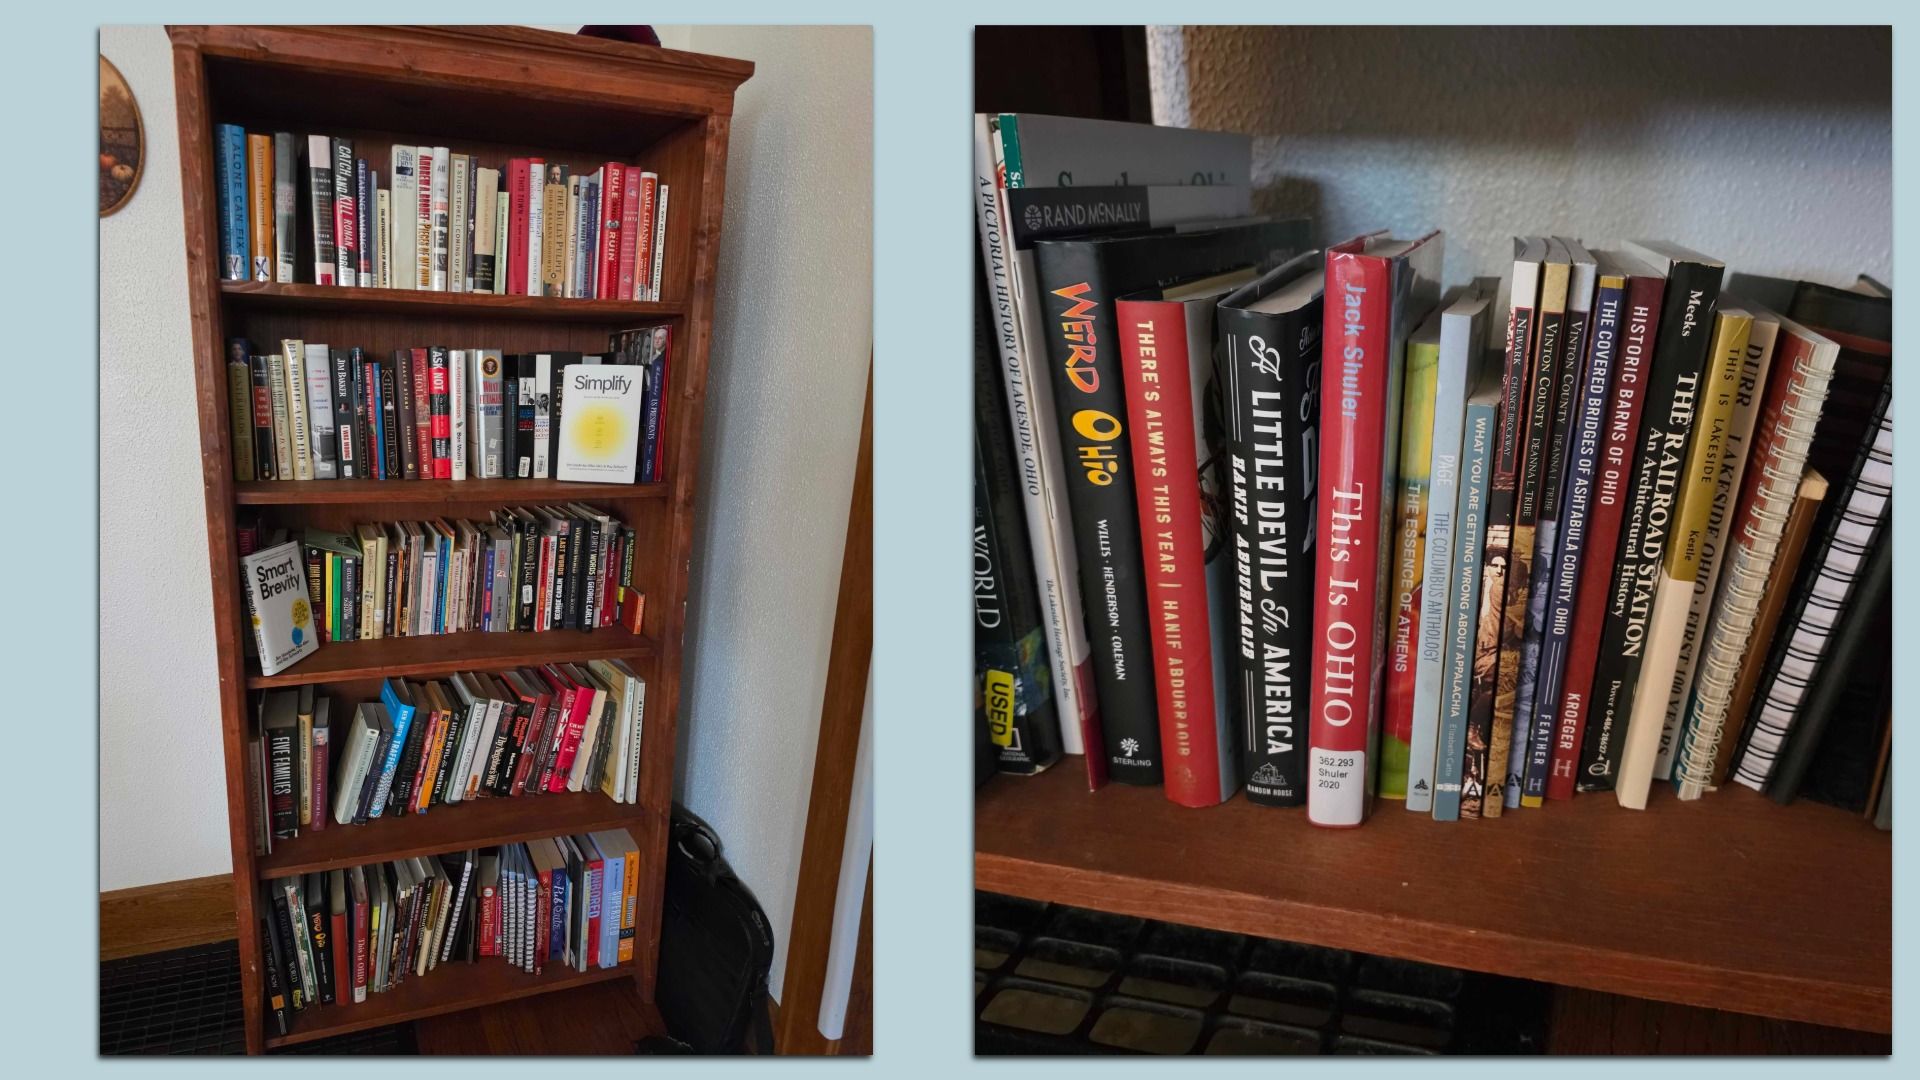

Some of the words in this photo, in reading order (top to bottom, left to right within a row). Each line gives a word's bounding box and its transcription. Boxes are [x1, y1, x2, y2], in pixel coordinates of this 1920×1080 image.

[233, 144, 241, 189] ALONE
[256, 144, 266, 182] Amazon
[339, 146, 352, 176] CATCH
[336, 175, 348, 192] AND
[611, 168, 619, 198] RULE
[979, 176, 991, 188] A
[235, 196, 243, 222] CAN
[340, 194, 353, 215] KILL
[517, 194, 525, 215] TOWN
[1044, 204, 1086, 227] RAND
[236, 229, 244, 248] FIX
[556, 210, 564, 239] BULLY
[641, 212, 650, 253] CHANGE
[981, 193, 1006, 281] PICTORIAL
[455, 259, 460, 267] OF
[555, 242, 563, 273] PULPIT
[996, 285, 1016, 353] HISTORY
[1344, 283, 1367, 337] Jack
[1602, 301, 1618, 327] THE
[1682, 289, 1704, 338] Meeks
[1248, 334, 1283, 382] A
[1512, 317, 1528, 365] NEWARK
[1542, 322, 1558, 375] VINTON
[1565, 321, 1583, 375] VINTON
[1621, 306, 1649, 384] HISTORIC
[337, 358, 345, 370] JIM
[433, 351, 442, 369] ASK
[1008, 354, 1020, 373] OF
[1136, 320, 1160, 402] THERE'S
[1591, 330, 1614, 395] COVERED
[1724, 349, 1740, 381] THIS
[1735, 344, 1764, 408] DURR
[338, 372, 346, 397] BAKKER
[434, 373, 444, 390] NOT
[575, 375, 632, 394] Simplify
[1341, 346, 1365, 420] Shuler
[1508, 376, 1519, 413] CHANCE
[1557, 374, 1575, 425] COUNTY
[1669, 372, 1699, 426] THE
[1718, 394, 1730, 406] IS
[1011, 375, 1031, 456] LAKESIDE,
[1533, 377, 1552, 427] COUNTY
[1611, 388, 1635, 443] BARNS
[648, 407, 657, 440] PRESIDENTS
[1251, 390, 1285, 491] LITTLE
[1473, 417, 1486, 451] WHAT
[1504, 415, 1515, 457] BROCKWAY
[1582, 397, 1603, 455] BRIDGES
[1645, 427, 1664, 452] An
[1145, 411, 1168, 478] ALWAYS
[1528, 438, 1540, 477] DEANNA
[1551, 434, 1562, 474] DEANNA
[1610, 446, 1625, 465] OF
[1701, 418, 1725, 483] LAKESIDE
[1024, 458, 1040, 496] OHIO
[1437, 455, 1455, 486] PAGE
[1472, 452, 1485, 483] YOU
[1577, 458, 1594, 476] OF
[1707, 433, 1741, 538] LAKESIDE
[1153, 485, 1171, 524] THIS
[1231, 454, 1249, 525] HANIF
[1408, 484, 1420, 514] THE
[1470, 485, 1481, 509] ARE
[1523, 489, 1534, 517] TRIBE
[1544, 486, 1555, 512] TRIBE
[1600, 468, 1620, 505] OHIO
[1643, 431, 1685, 558] RAILROAD
[1330, 482, 1364, 563] This
[1434, 512, 1450, 535] THE
[1564, 478, 1588, 555] ASHTABULA
[1624, 456, 1656, 560] Architectural
[591, 535, 599, 553] DIRTY
[1097, 519, 1112, 557] WILLIS
[1157, 525, 1176, 574] YEAR
[1256, 497, 1289, 592] DEVIL
[1401, 519, 1418, 588] ESSENCE
[1463, 512, 1477, 563] GETTING
[1684, 530, 1700, 561] Kestle
[256, 558, 295, 583] Smart
[589, 554, 598, 575] WORDS
[974, 525, 1001, 628] WORLD
[1430, 538, 1448, 598] COLUMBUS
[1556, 556, 1578, 607] COUNTY,
[1692, 543, 1716, 595] OHIO
[247, 591, 257, 616] Brevity
[260, 574, 300, 600] Brevity
[586, 581, 594, 604] GEORGE
[1045, 578, 1053, 592] The
[1103, 565, 1120, 627] HENDERSON
[1328, 576, 1359, 606] Is
[1400, 592, 1413, 613] OF
[1461, 564, 1473, 609] WRONG
[1611, 563, 1637, 617] History
[585, 605, 593, 625] CARLIN
[1047, 593, 1061, 630] Lakeside
[1163, 600, 1182, 650] HANIF
[1259, 598, 1289, 635] In
[1552, 608, 1568, 636] OHIO
[1622, 559, 1655, 658] STATION
[1395, 616, 1412, 673] ATHENS
[1423, 600, 1442, 663] ANTHOLOGY
[1456, 612, 1468, 652] ABOUT
[1678, 610, 1700, 665] FIRST
[1110, 636, 1126, 681] COLEMAN
[1322, 621, 1357, 727] OHIO
[1263, 643, 1293, 755] AMERICA
[1450, 653, 1466, 718] APPALACHIA
[1608, 680, 1621, 707] Dover
[1671, 669, 1687, 694] 100
[561, 709, 571, 723] K
[991, 682, 1009, 736] USED
[1559, 693, 1581, 750] KROEGER
[272, 736, 290, 755] FIVE
[449, 722, 458, 740] LITTLE
[496, 736, 507, 747] Thy
[552, 737, 563, 751] K
[557, 723, 567, 737] K
[1448, 723, 1457, 756] Elizabeth
[1534, 713, 1552, 765] FEATHER
[1655, 699, 1681, 757] YEARS
[385, 740, 401, 770] TRAFFIC
[443, 741, 453, 759] DEVIL
[1113, 756, 1151, 767] STERLING
[1319, 756, 1354, 767] 362.293
[273, 757, 291, 796] FAMILIES
[434, 769, 445, 794] AMERICA
[1247, 784, 1271, 796] RANDOM
[1318, 768, 1348, 779] Shuler
[1318, 779, 1340, 790] 2020
